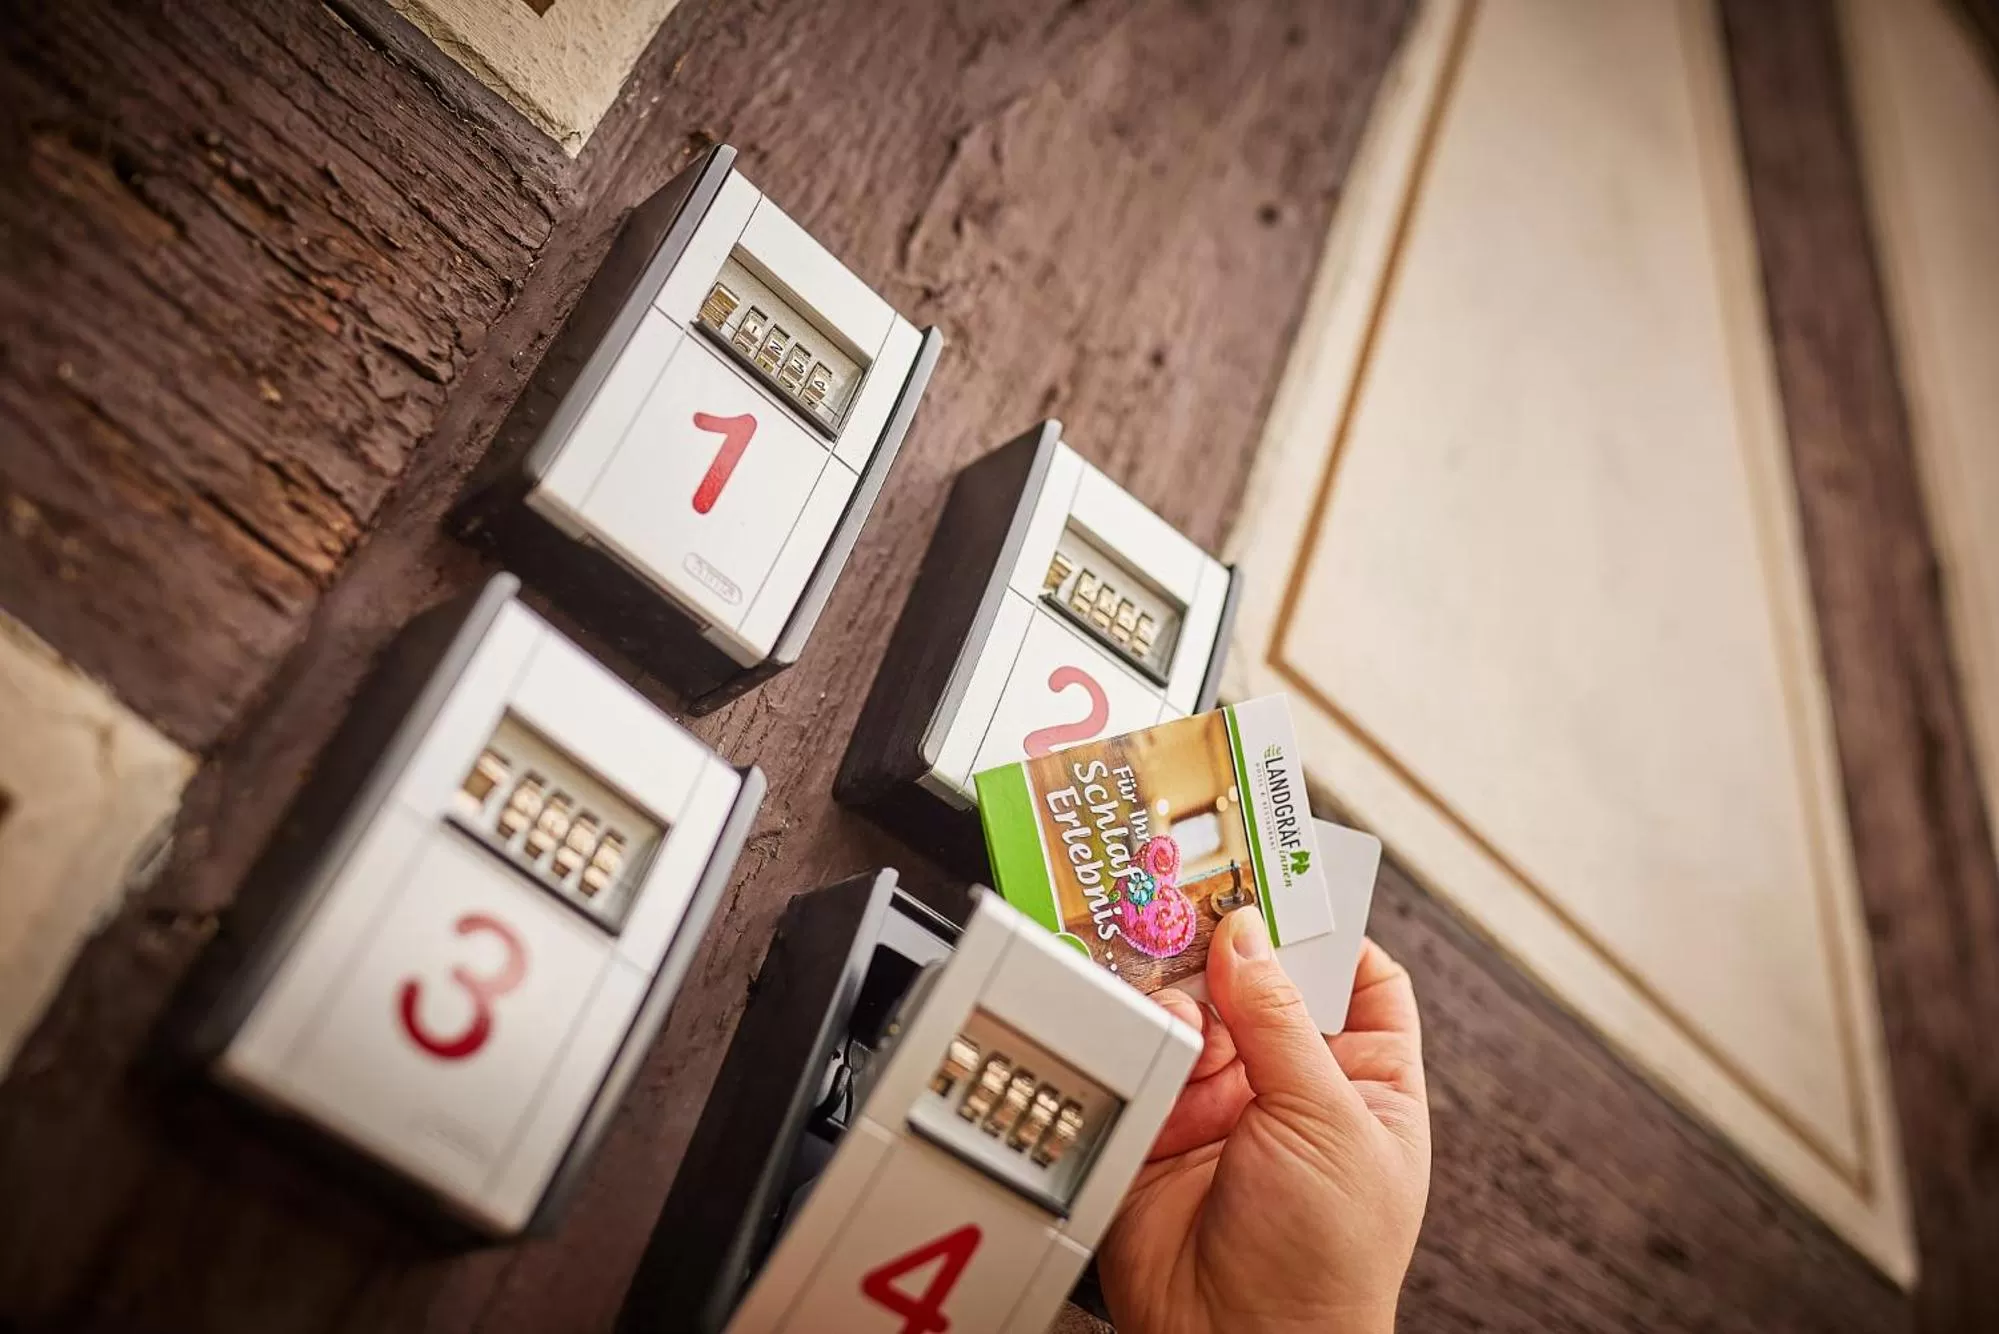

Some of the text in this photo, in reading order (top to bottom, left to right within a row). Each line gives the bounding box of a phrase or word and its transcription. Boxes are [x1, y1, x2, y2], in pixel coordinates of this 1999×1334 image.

[692, 412, 758, 515] 1
[1023, 665, 1110, 758] 2
[1073, 760, 1149, 879] Schlaf
[1113, 765, 1149, 842] Für Ihr
[1047, 785, 1121, 941] Erlebnis
[396, 914, 528, 1062] 3
[859, 1221, 983, 1334] 4
